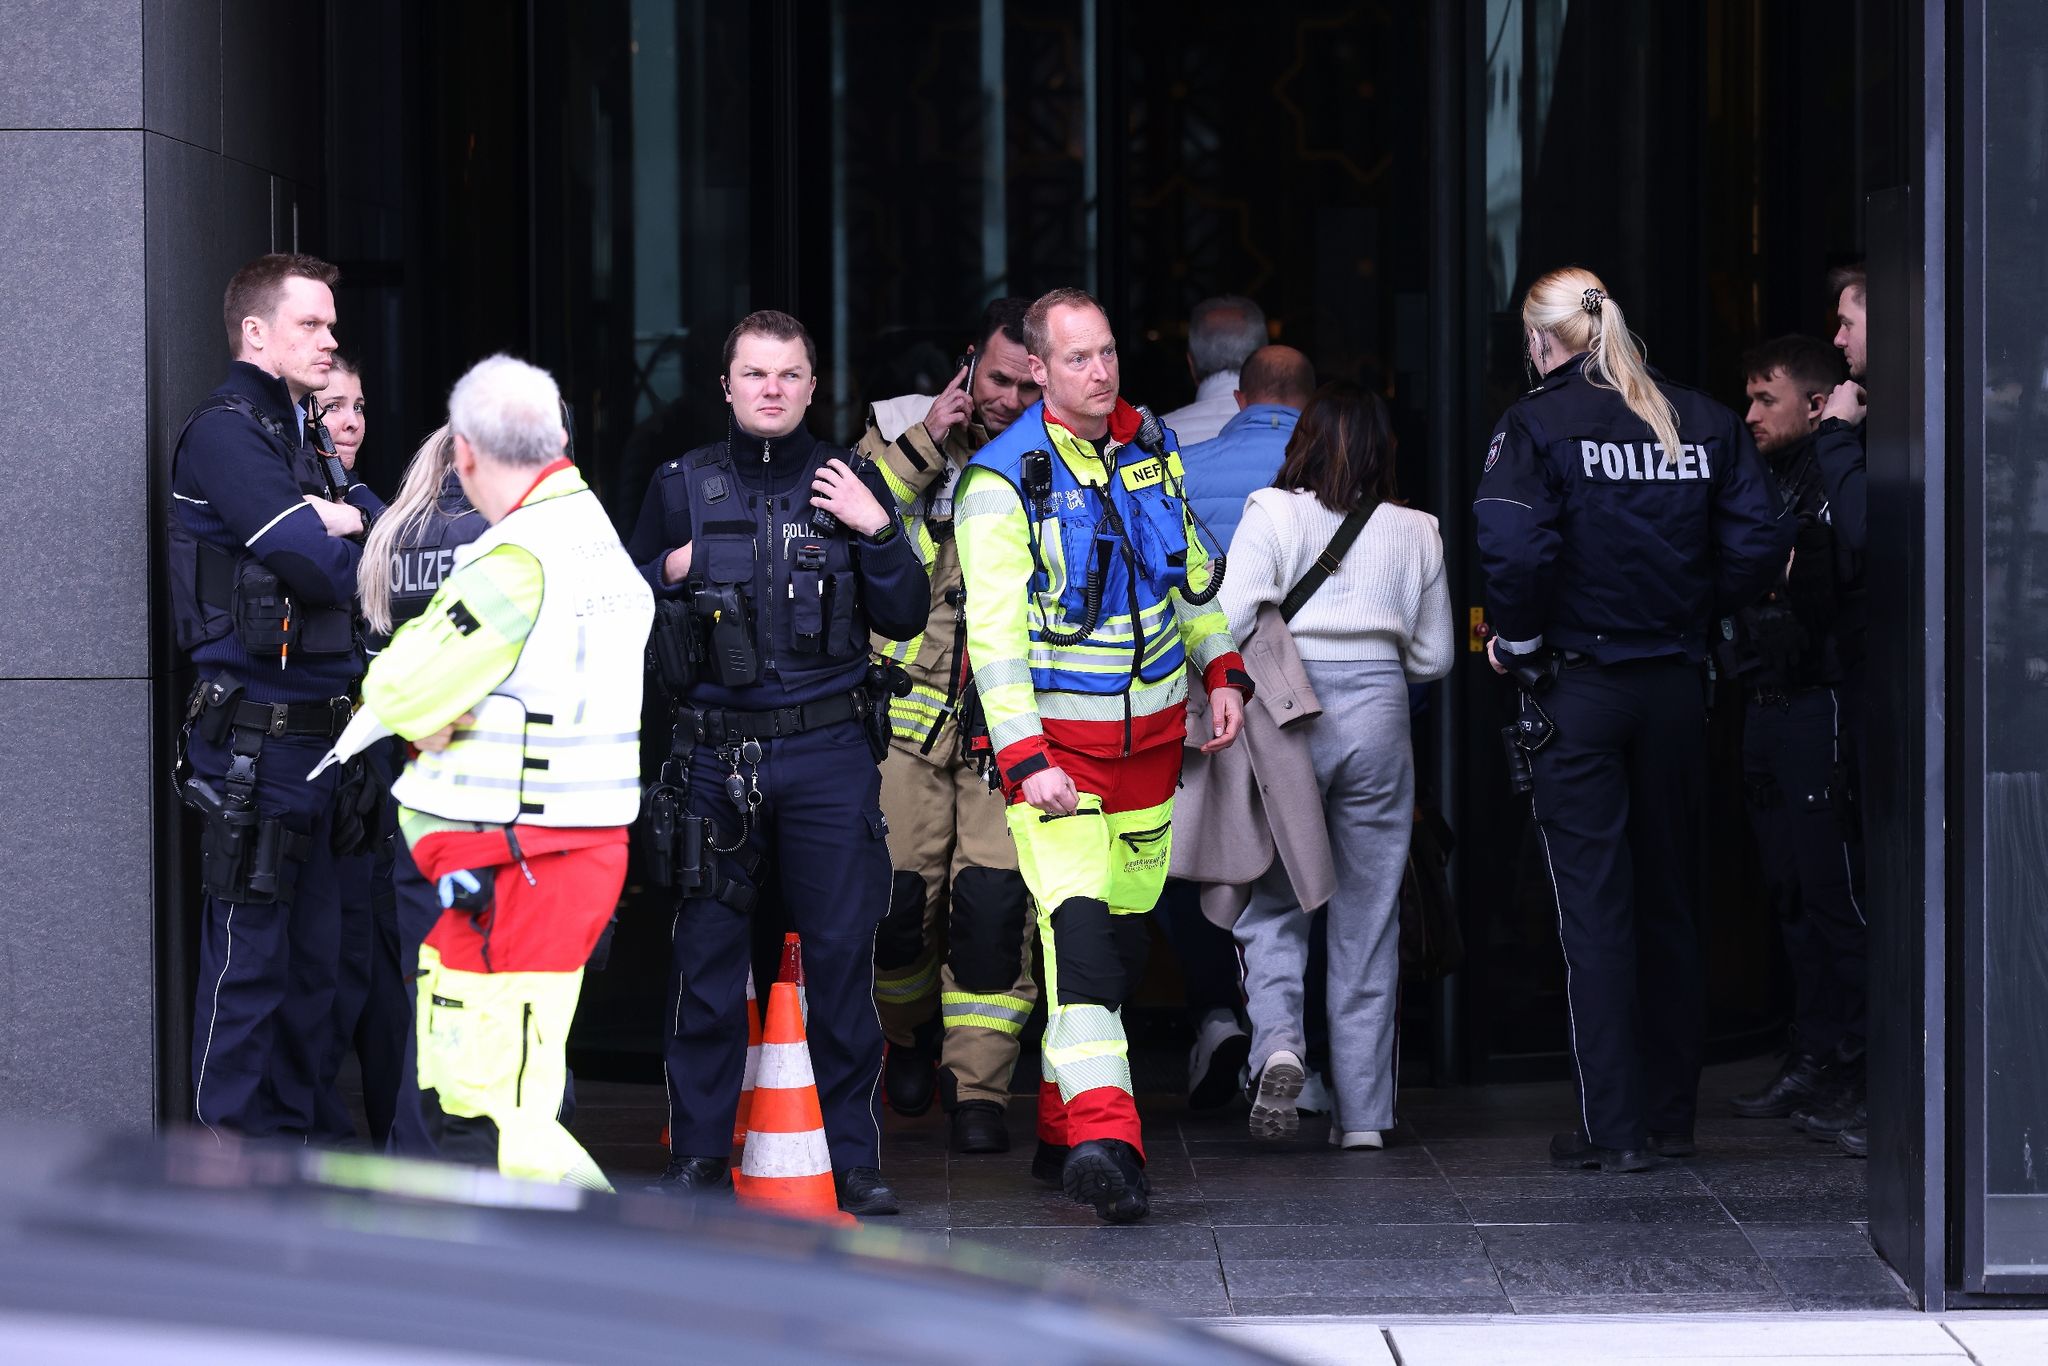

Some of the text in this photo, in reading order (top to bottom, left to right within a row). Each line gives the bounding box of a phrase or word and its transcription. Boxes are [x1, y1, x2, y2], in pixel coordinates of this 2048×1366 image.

[1132, 463, 1160, 483] NEF
[1581, 440, 1711, 481] POLIZEI
[390, 549, 453, 593] OLIZE
